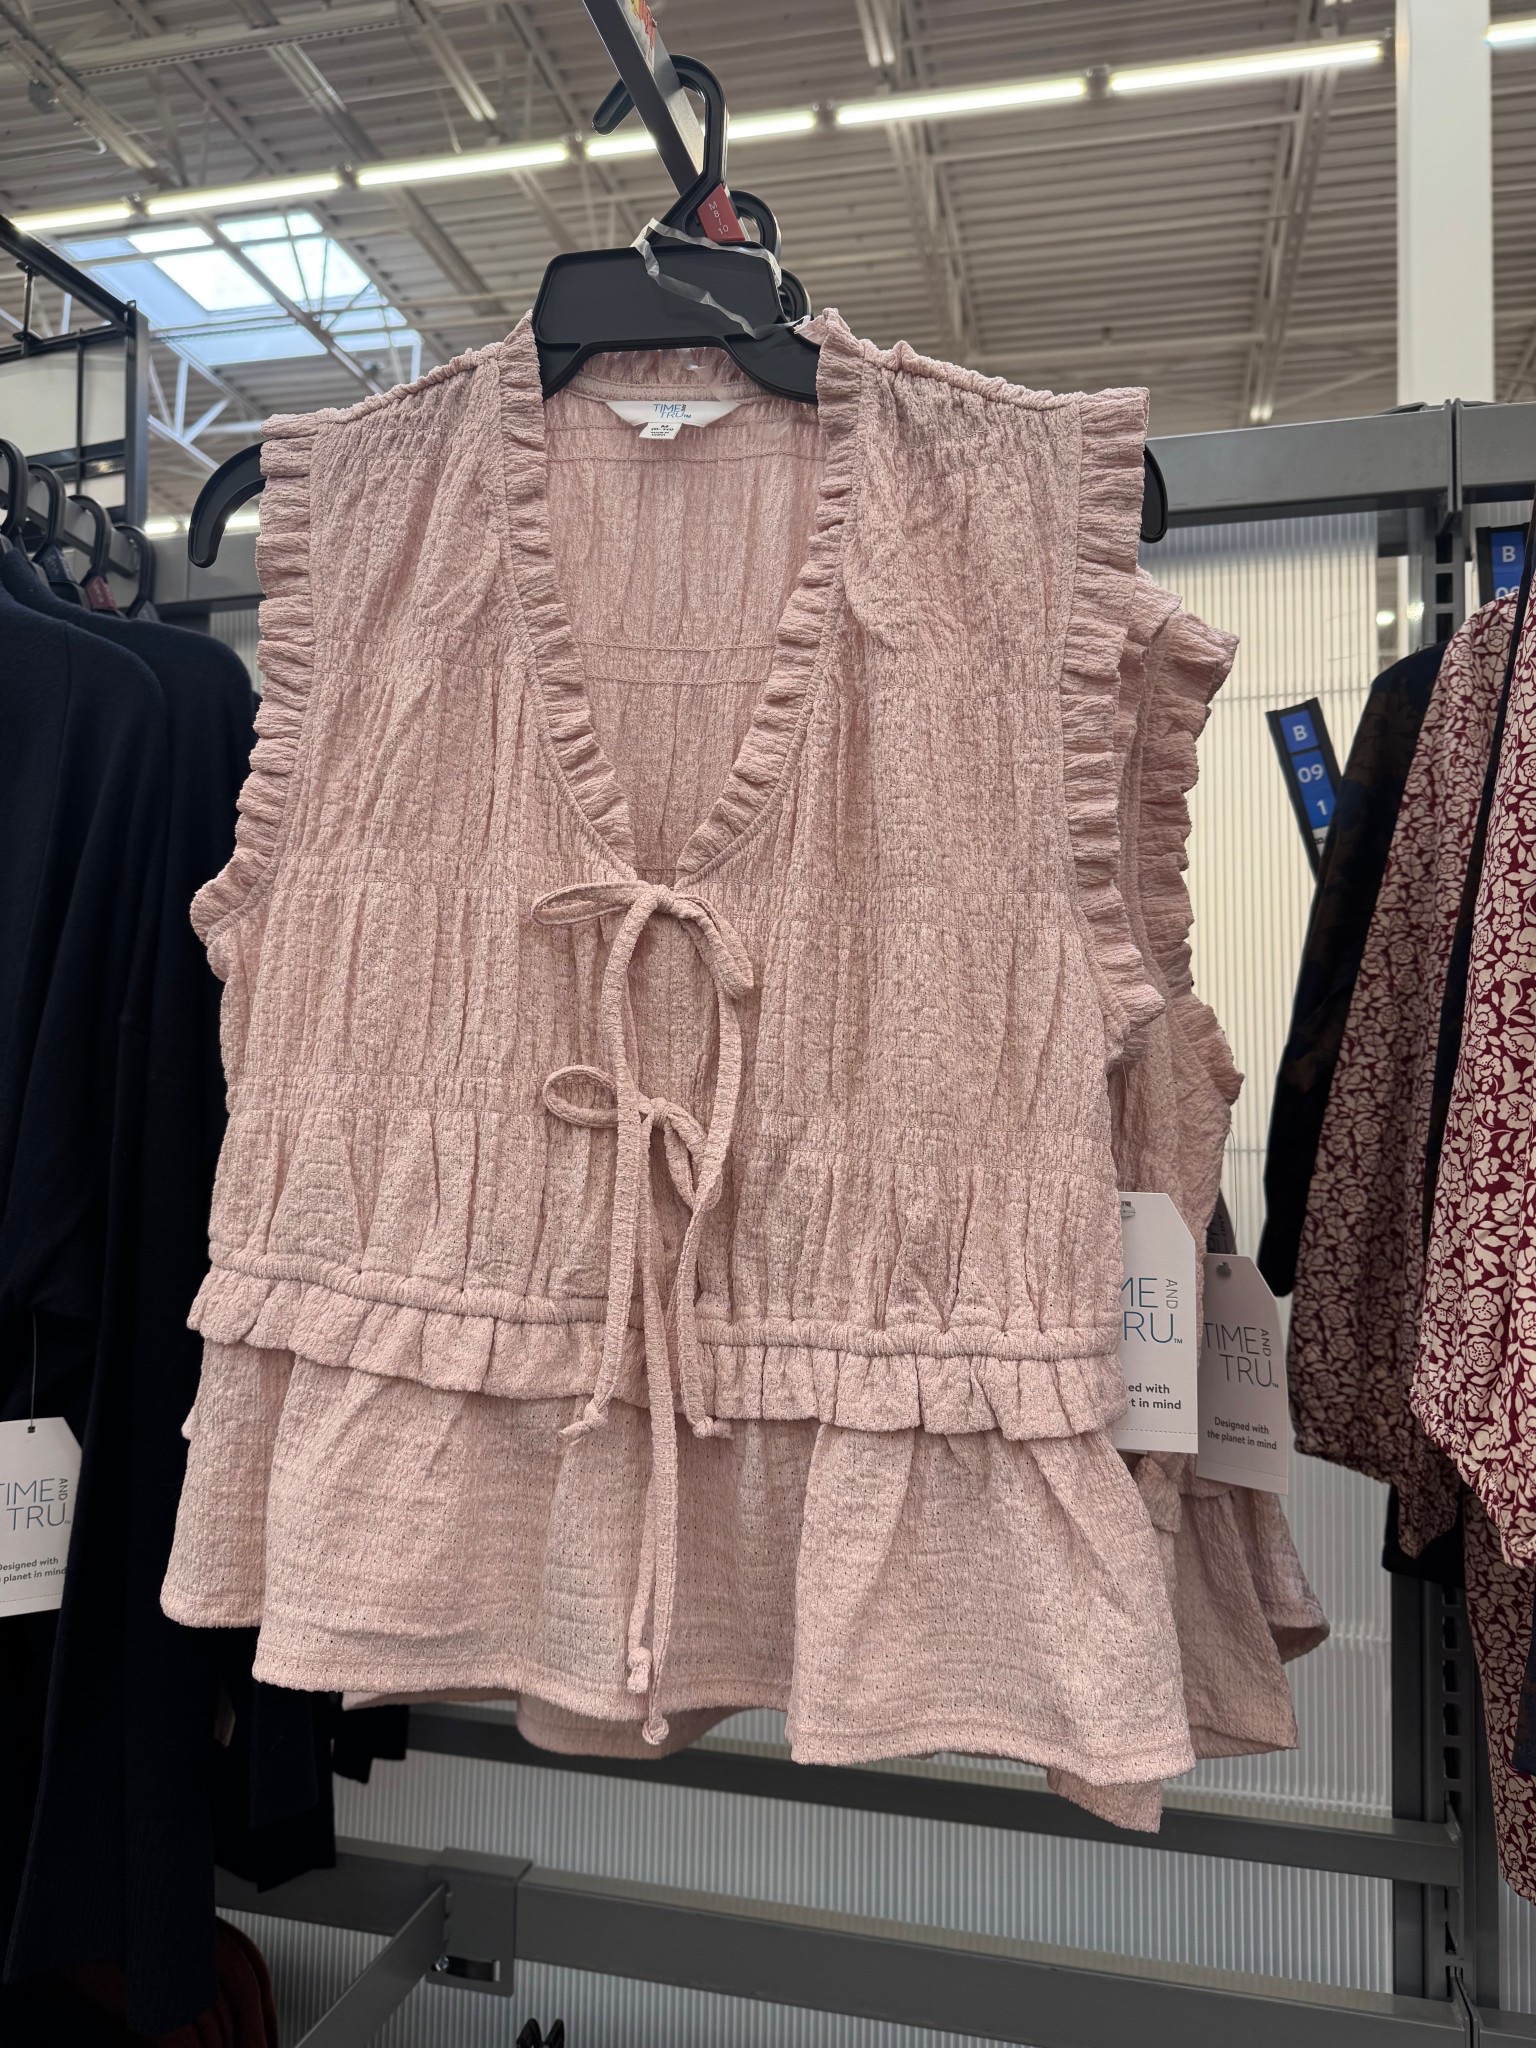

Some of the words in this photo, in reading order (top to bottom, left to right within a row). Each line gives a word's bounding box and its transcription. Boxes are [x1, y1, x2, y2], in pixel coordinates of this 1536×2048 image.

[708, 200, 718, 211] M
[653, 403, 681, 412] TIME
[660, 411, 684, 419] TRU
[1502, 545, 1516, 563] B
[1292, 725, 1308, 742] B
[1297, 763, 1324, 783] 09
[1316, 799, 1327, 816] 1
[1165, 1278, 1179, 1310] AND
[1124, 1311, 1174, 1344] RU
[1203, 1322, 1260, 1355] TIME
[1260, 1327, 1272, 1357] AND
[1219, 1353, 1272, 1388] TRU
[1145, 1384, 1170, 1394] with
[1139, 1398, 1149, 1408] in
[1152, 1399, 1182, 1410] mind
[1214, 1416, 1250, 1431] Designed
[1251, 1423, 1269, 1434] with
[1207, 1429, 1220, 1440] the
[1221, 1432, 1246, 1445] planet
[1247, 1436, 1255, 1446] in
[1256, 1439, 1277, 1450] mind
[59, 1478, 69, 1501] AND
[6, 1502, 66, 1531] TRU
[40, 1556, 59, 1566] with
[3, 1572, 31, 1584] planet
[34, 1570, 42, 1578] in
